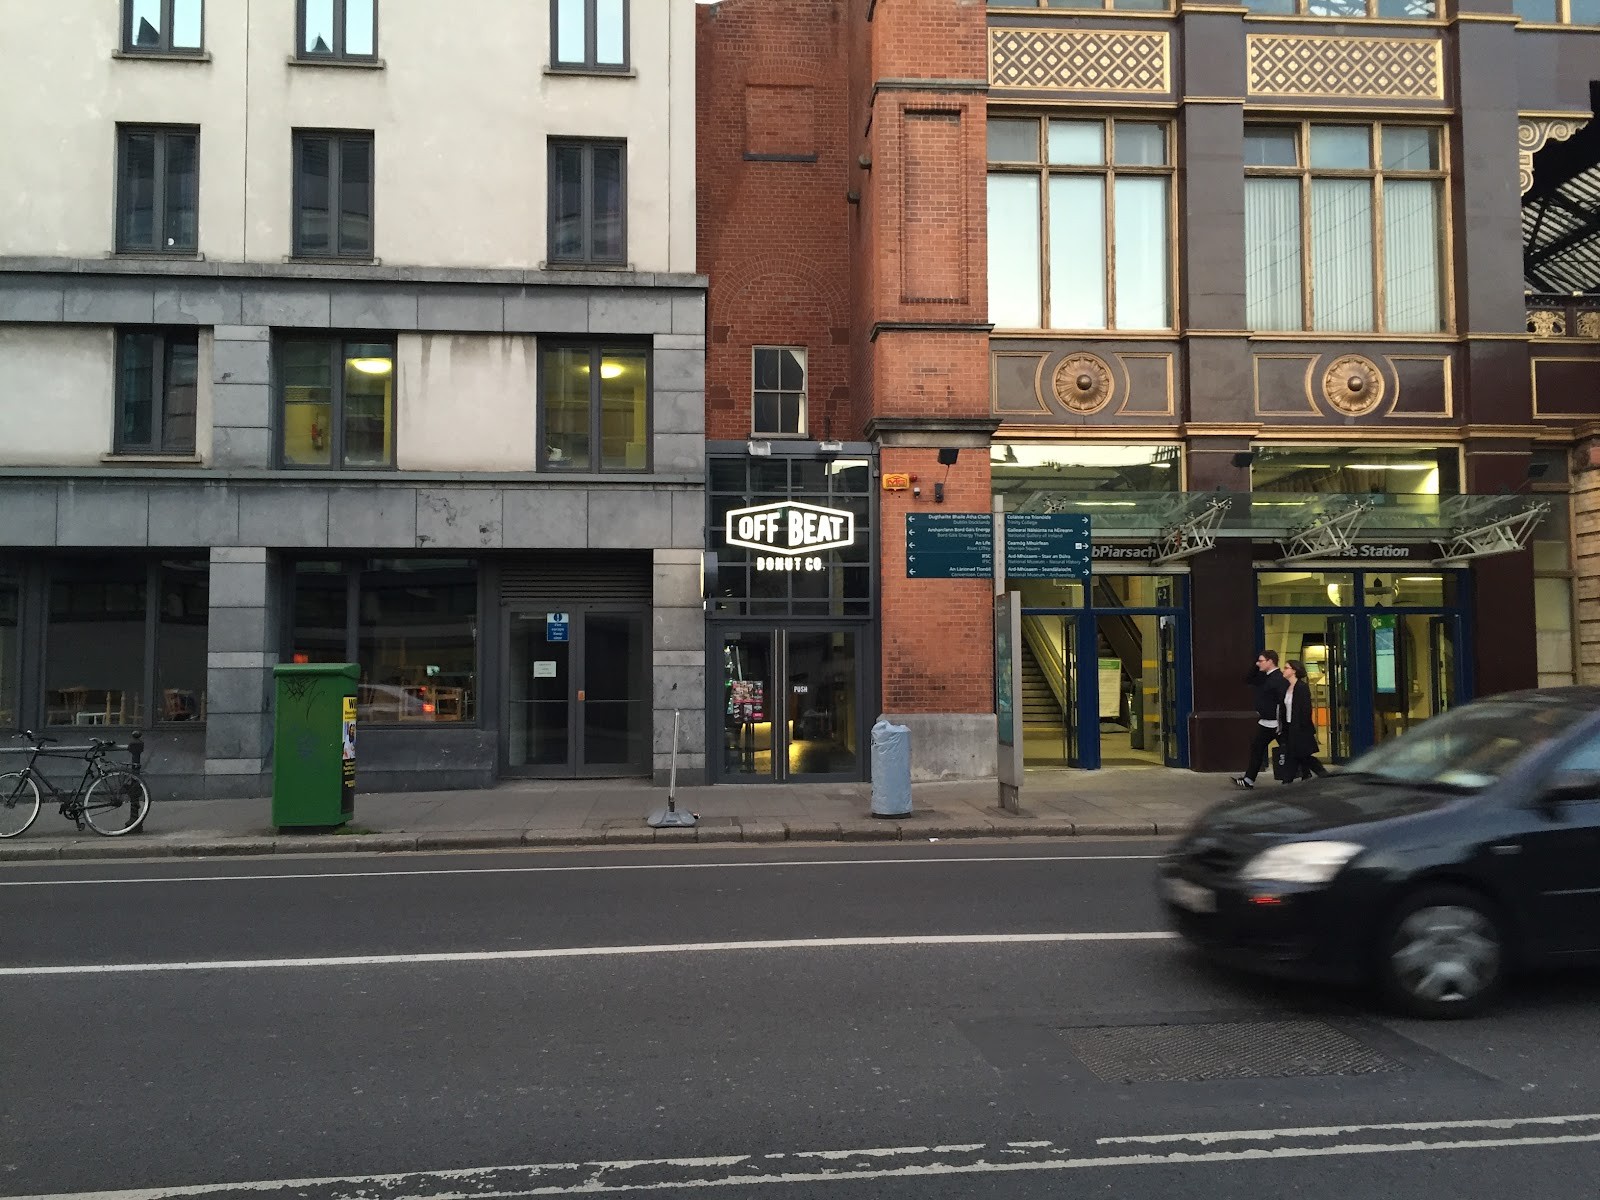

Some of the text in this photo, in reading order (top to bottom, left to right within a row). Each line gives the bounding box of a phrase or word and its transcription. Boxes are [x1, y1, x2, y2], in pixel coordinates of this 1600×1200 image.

[738, 510, 844, 546] OFF BEAT
[1091, 545, 1157, 558] bPiarsach
[1360, 545, 1409, 557] Station
[756, 557, 802, 571] DONUT
